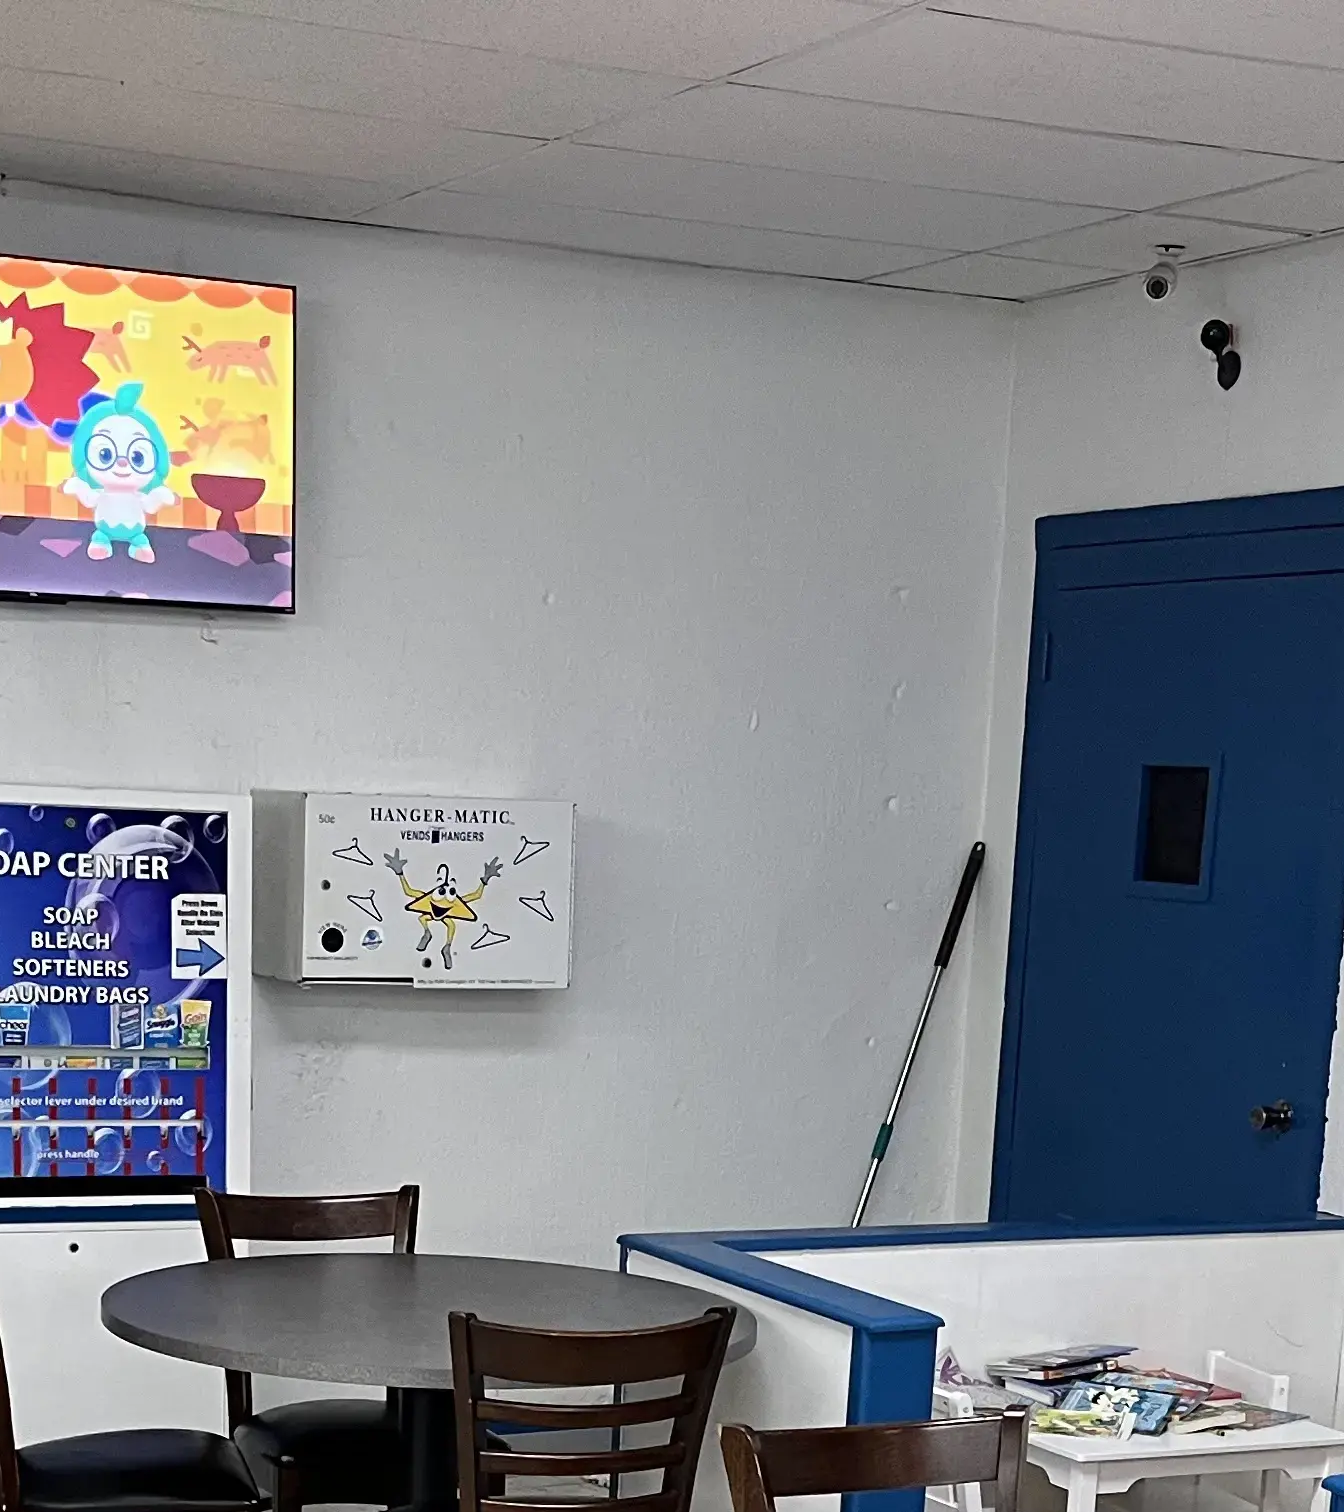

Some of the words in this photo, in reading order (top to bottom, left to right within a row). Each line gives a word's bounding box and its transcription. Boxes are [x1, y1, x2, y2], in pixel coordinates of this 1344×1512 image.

[370, 807, 511, 825] HANGER-MATIC
[400, 830, 431, 841] VENDS
[441, 831, 484, 842] HANGERS
[57, 852, 169, 880] CENTER
[43, 906, 99, 925] SOAP
[30, 931, 110, 950] BLEACH
[12, 958, 129, 978] SOFTENERS
[96, 986, 150, 1005] BAGS
[45, 1096, 72, 1106] lever
[74, 1096, 107, 1106] under
[109, 1096, 149, 1106] desired
[151, 1096, 184, 1106] brand
[36, 1150, 63, 1160] press
[65, 1149, 100, 1159] handle
